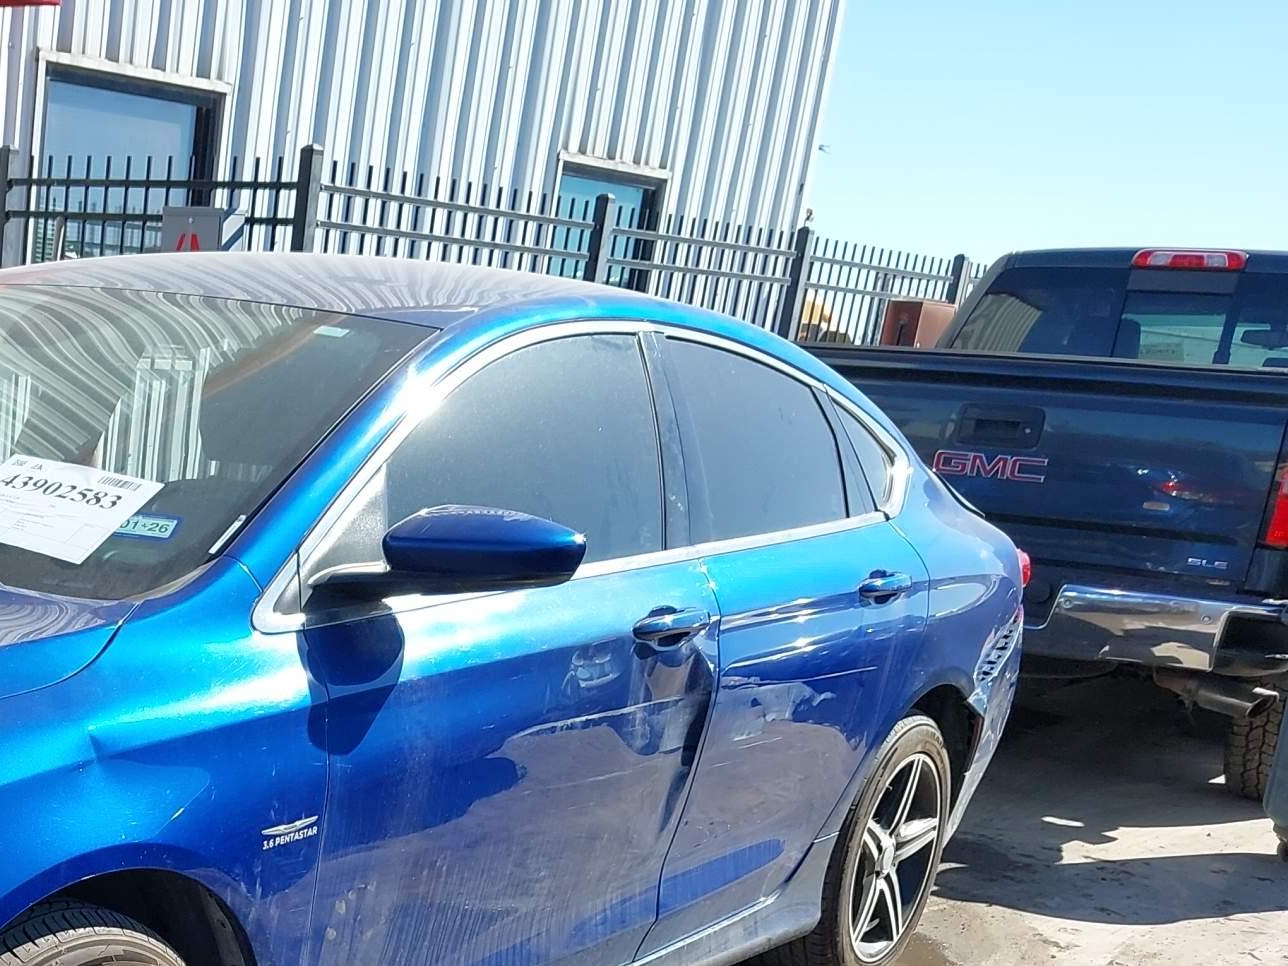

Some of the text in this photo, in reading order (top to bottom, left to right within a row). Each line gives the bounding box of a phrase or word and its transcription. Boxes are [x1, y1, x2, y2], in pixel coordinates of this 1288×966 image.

[933, 450, 1048, 483] GMC
[0, 473, 122, 510] 43902583
[275, 826, 318, 847] PENTASTAR
